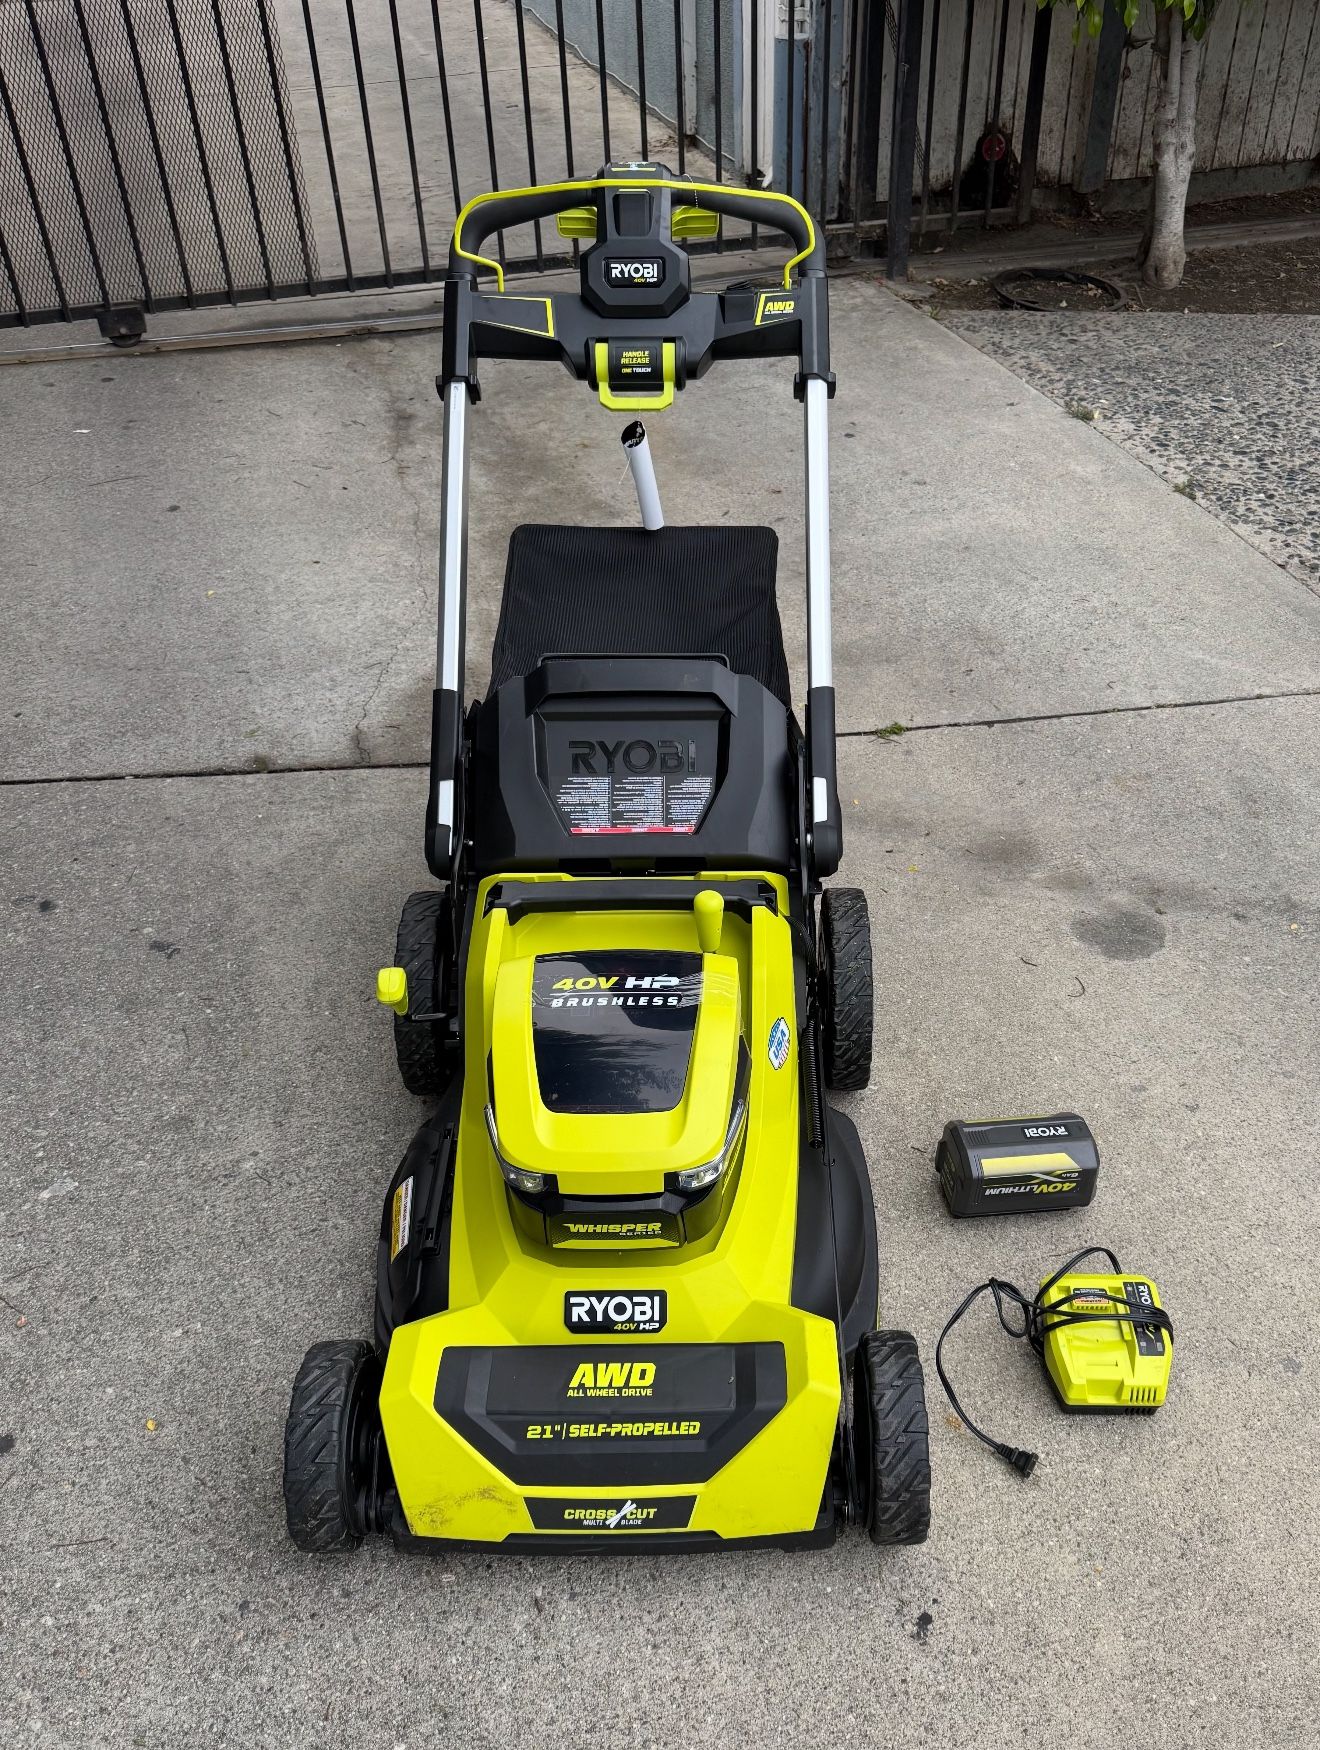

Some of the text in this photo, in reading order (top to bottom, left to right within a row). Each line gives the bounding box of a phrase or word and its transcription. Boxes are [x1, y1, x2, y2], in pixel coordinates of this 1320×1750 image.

[610, 263, 658, 278] RYOBI
[765, 300, 795, 311] AWD
[622, 350, 649, 358] HANDLE
[620, 357, 650, 365] RELEASE
[568, 739, 697, 775] RYOBI
[552, 976, 680, 991] 40V HP
[550, 996, 680, 1008] BRUSHLESS
[772, 1028, 787, 1061] USA
[1024, 1125, 1069, 1138] RYOBI
[562, 1222, 662, 1233] WHISPER
[569, 1295, 660, 1322] RYOBI
[638, 1322, 660, 1330] HP
[568, 1362, 656, 1388] AWD
[566, 1388, 653, 1397] ALL WHEEL DRIVE
[526, 1421, 701, 1439] 21" SELF-PROPELLED
[563, 1508, 658, 1520] CROSS CUT
